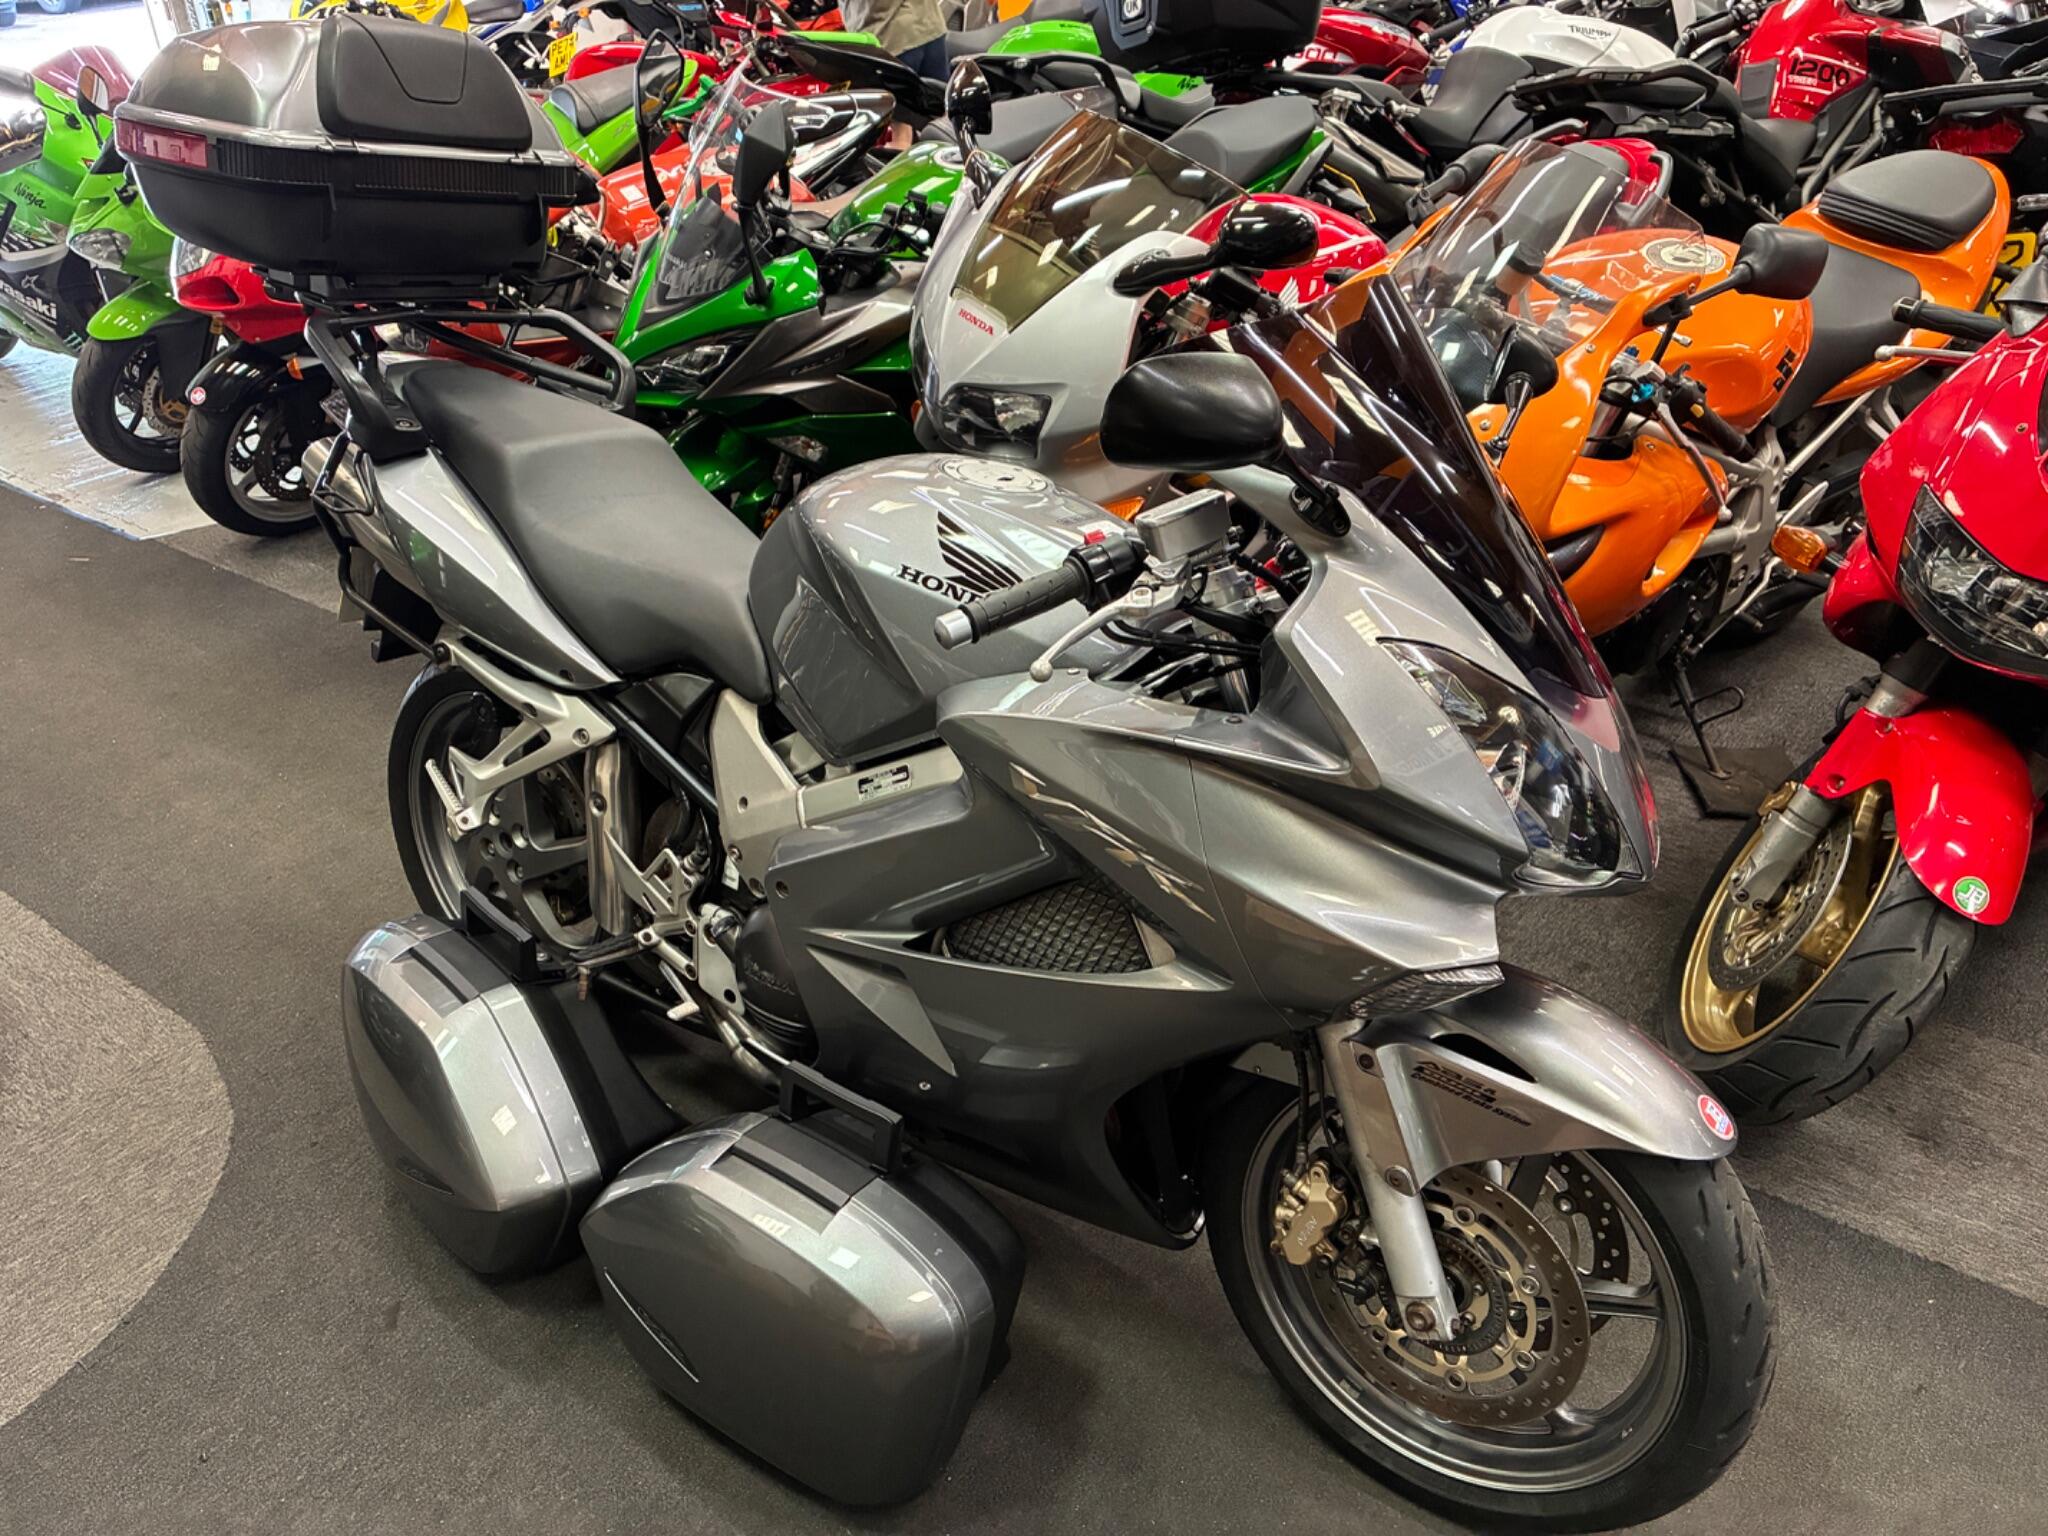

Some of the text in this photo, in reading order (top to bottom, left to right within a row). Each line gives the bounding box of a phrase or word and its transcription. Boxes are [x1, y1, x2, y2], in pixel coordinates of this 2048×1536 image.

[1568, 25, 1611, 37] TRIUMPH
[1789, 57, 1850, 86] 1200
[14, 182, 46, 209] Ninja
[0, 279, 57, 319] asaki
[959, 308, 993, 336] HONDA
[896, 563, 984, 604] HON
